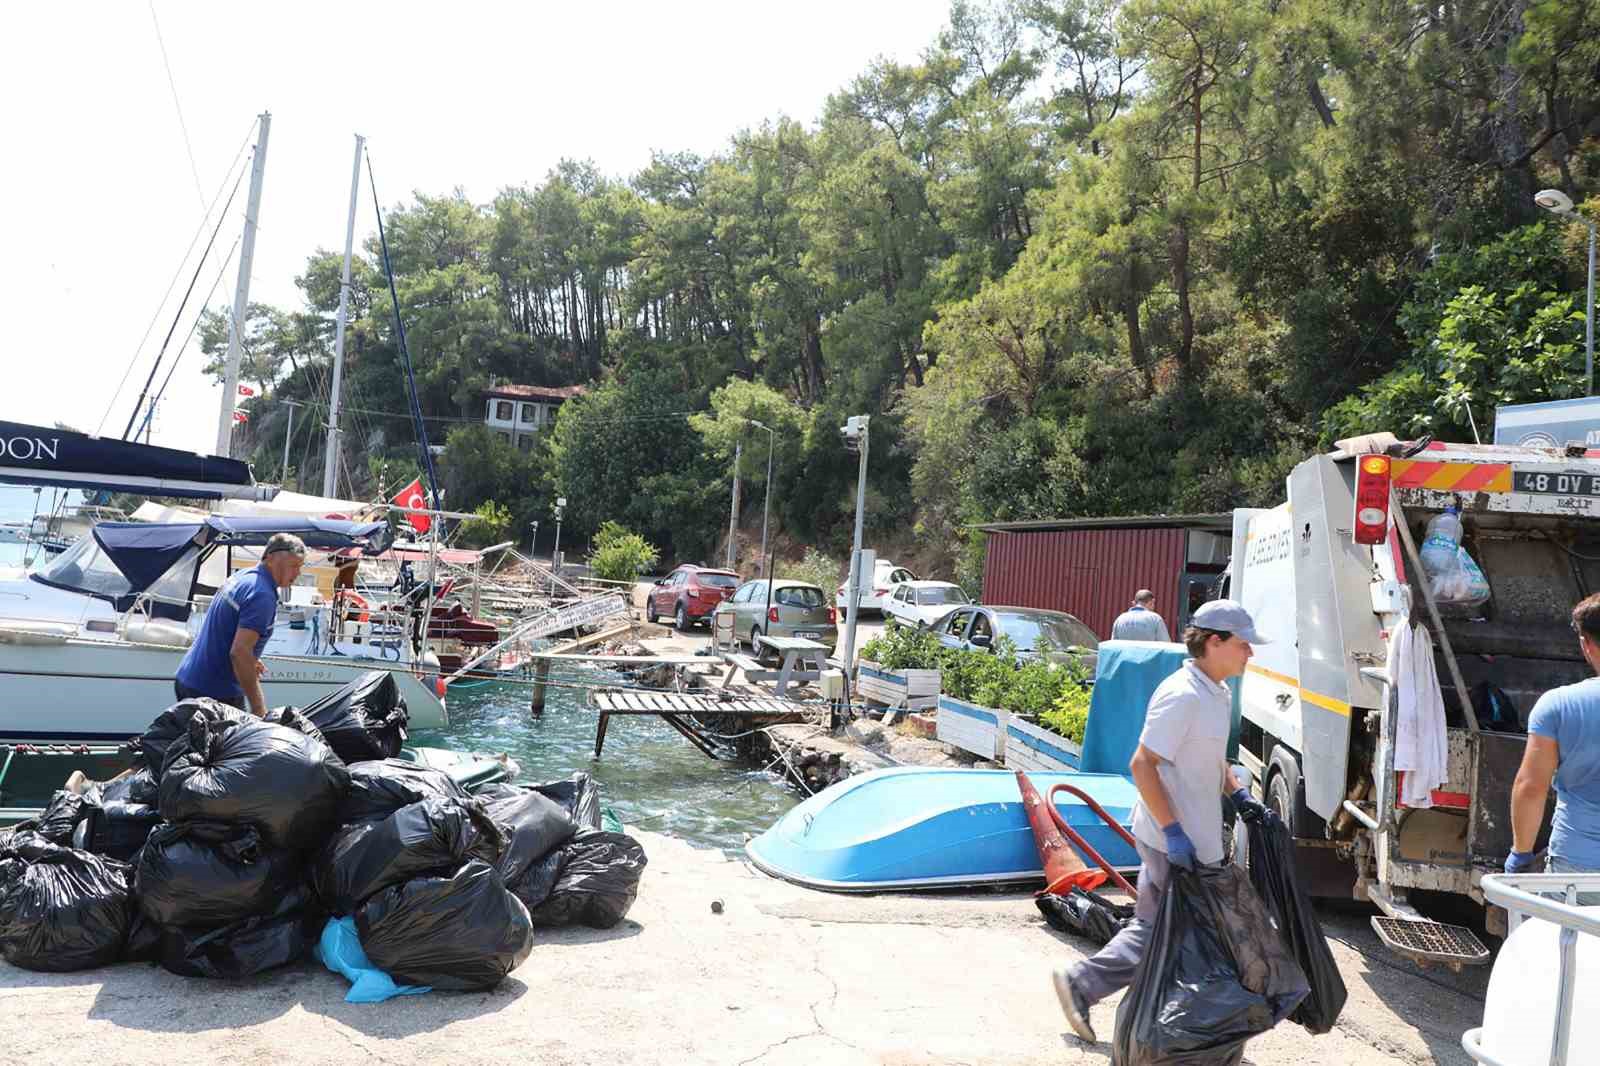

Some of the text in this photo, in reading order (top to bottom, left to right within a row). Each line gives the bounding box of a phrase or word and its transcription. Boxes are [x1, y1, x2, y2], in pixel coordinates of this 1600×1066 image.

[0, 436, 60, 460] ON
[1524, 474, 1549, 492] 48
[1557, 475, 1583, 493] DV
